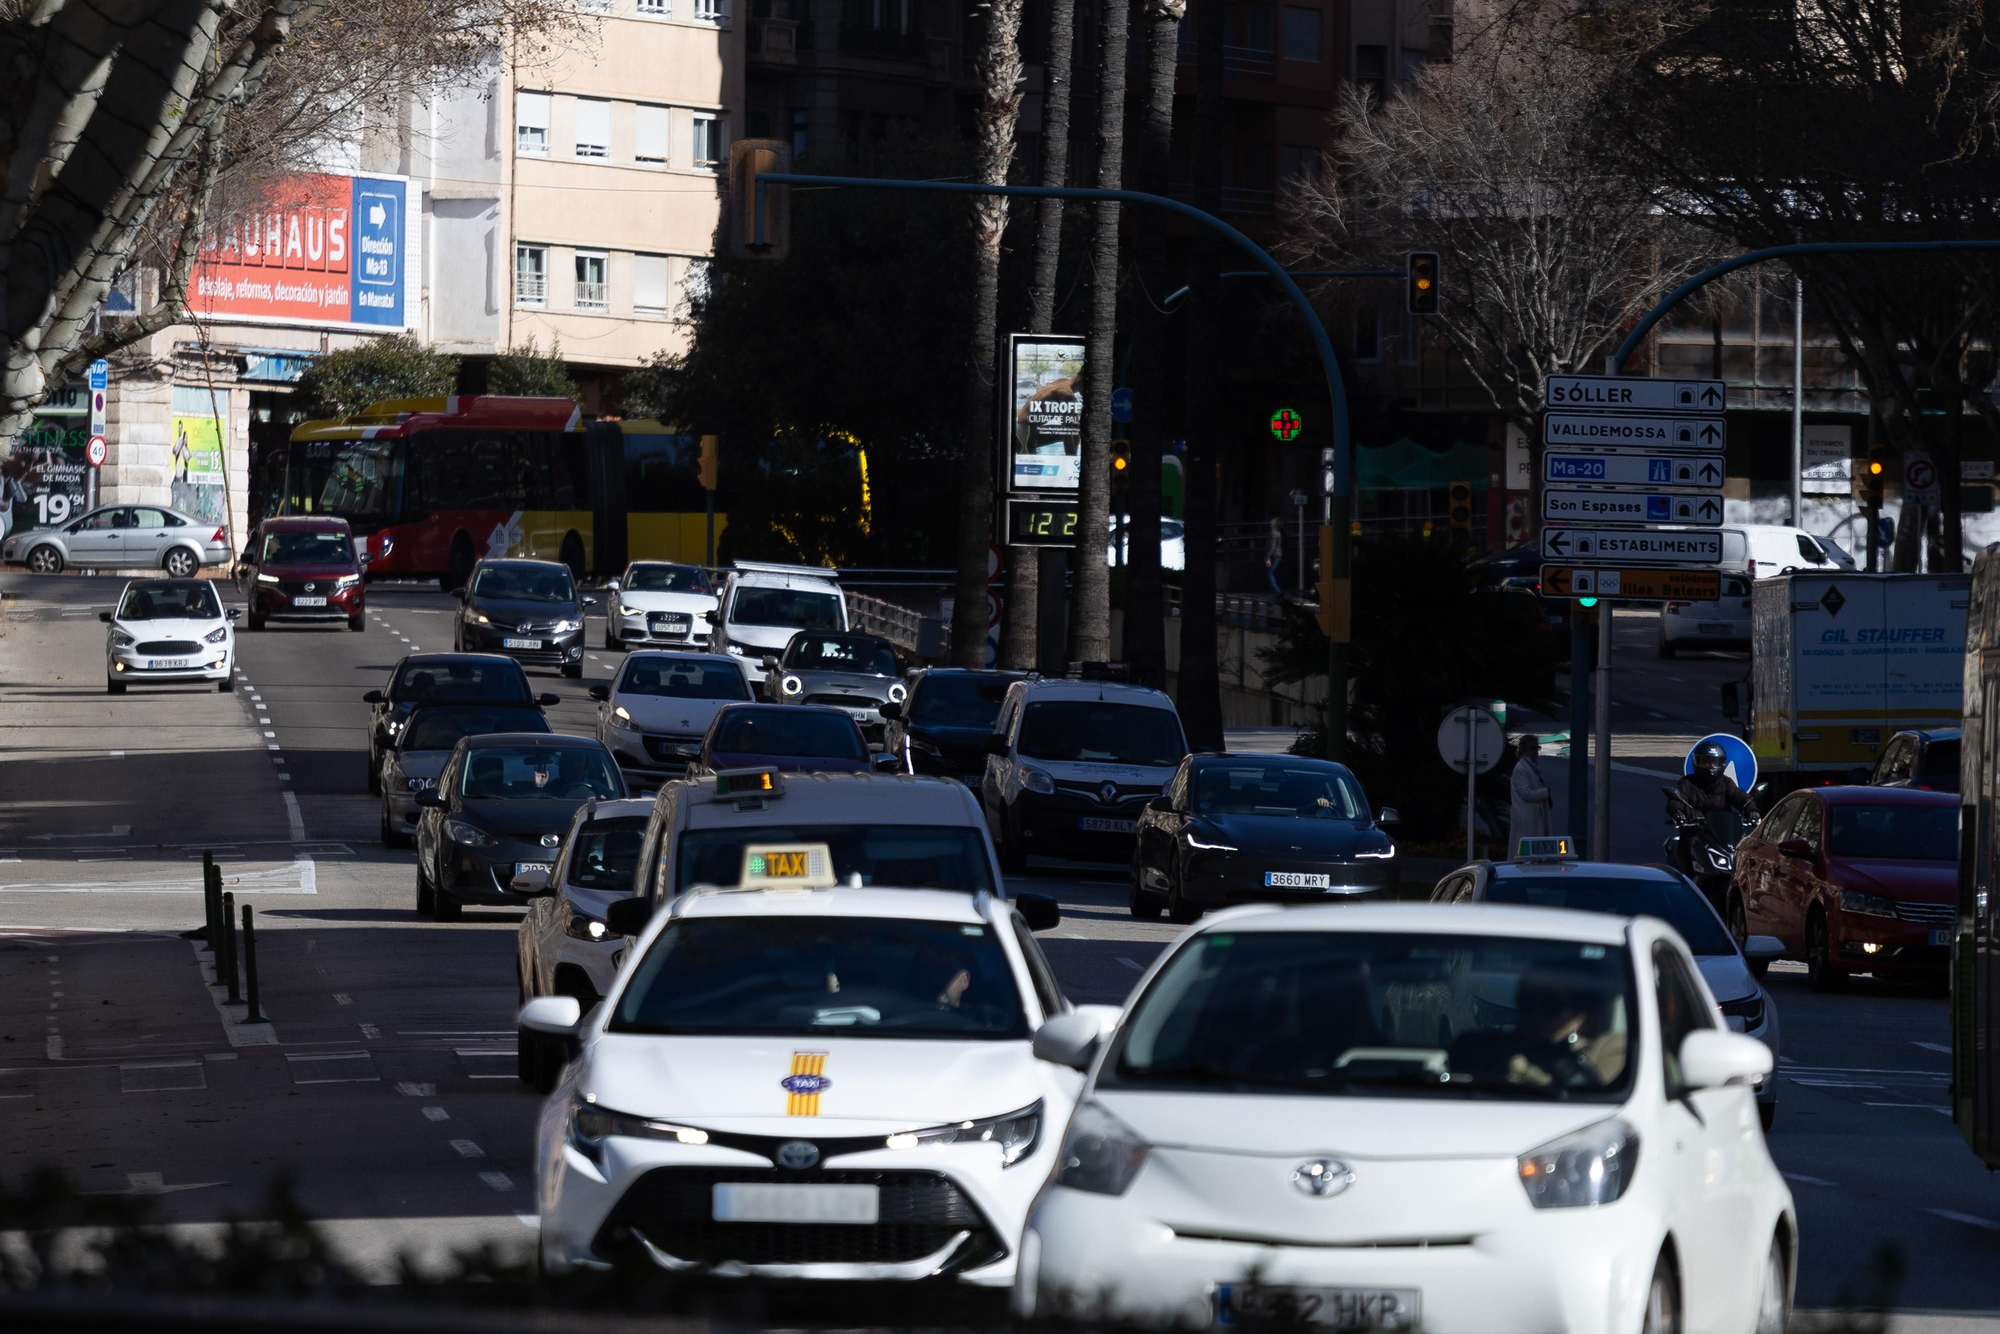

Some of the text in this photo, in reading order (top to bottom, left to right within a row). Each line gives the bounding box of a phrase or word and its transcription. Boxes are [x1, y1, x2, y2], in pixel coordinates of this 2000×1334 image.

[362, 235, 394, 256] Dirección
[365, 257, 389, 277] Ma-13
[198, 275, 349, 308] Bricolaje, reformas, decoración y jardín
[359, 290, 396, 309] En Marratxí
[91, 363, 107, 375] VAP
[1553, 382, 1633, 403] SÓLLER
[1029, 400, 1043, 413] IX
[1028, 414, 1053, 424] CIUTAT
[1552, 423, 1666, 439] VALLDEMOSSA
[1810, 440, 1845, 448] ESTAMOS
[92, 446, 103, 457] 40
[36, 464, 46, 473] EL
[1553, 461, 1604, 476] Ma-20
[43, 474, 81, 483] DE MODA
[1550, 499, 1642, 515] Son Espases
[1600, 539, 1718, 554] ESTABLIMENTS
[1669, 573, 1717, 585] velòdrom
[1623, 583, 1716, 597] Illes Balears
[1821, 628, 1946, 643] GIL STAUFFER
[761, 772, 773, 791] 1
[1085, 819, 1134, 831] 5879 KLY
[1532, 840, 1568, 855] TAXI 1
[1272, 873, 1327, 887] 3660 MRY
[792, 1078, 820, 1089] TAXI
